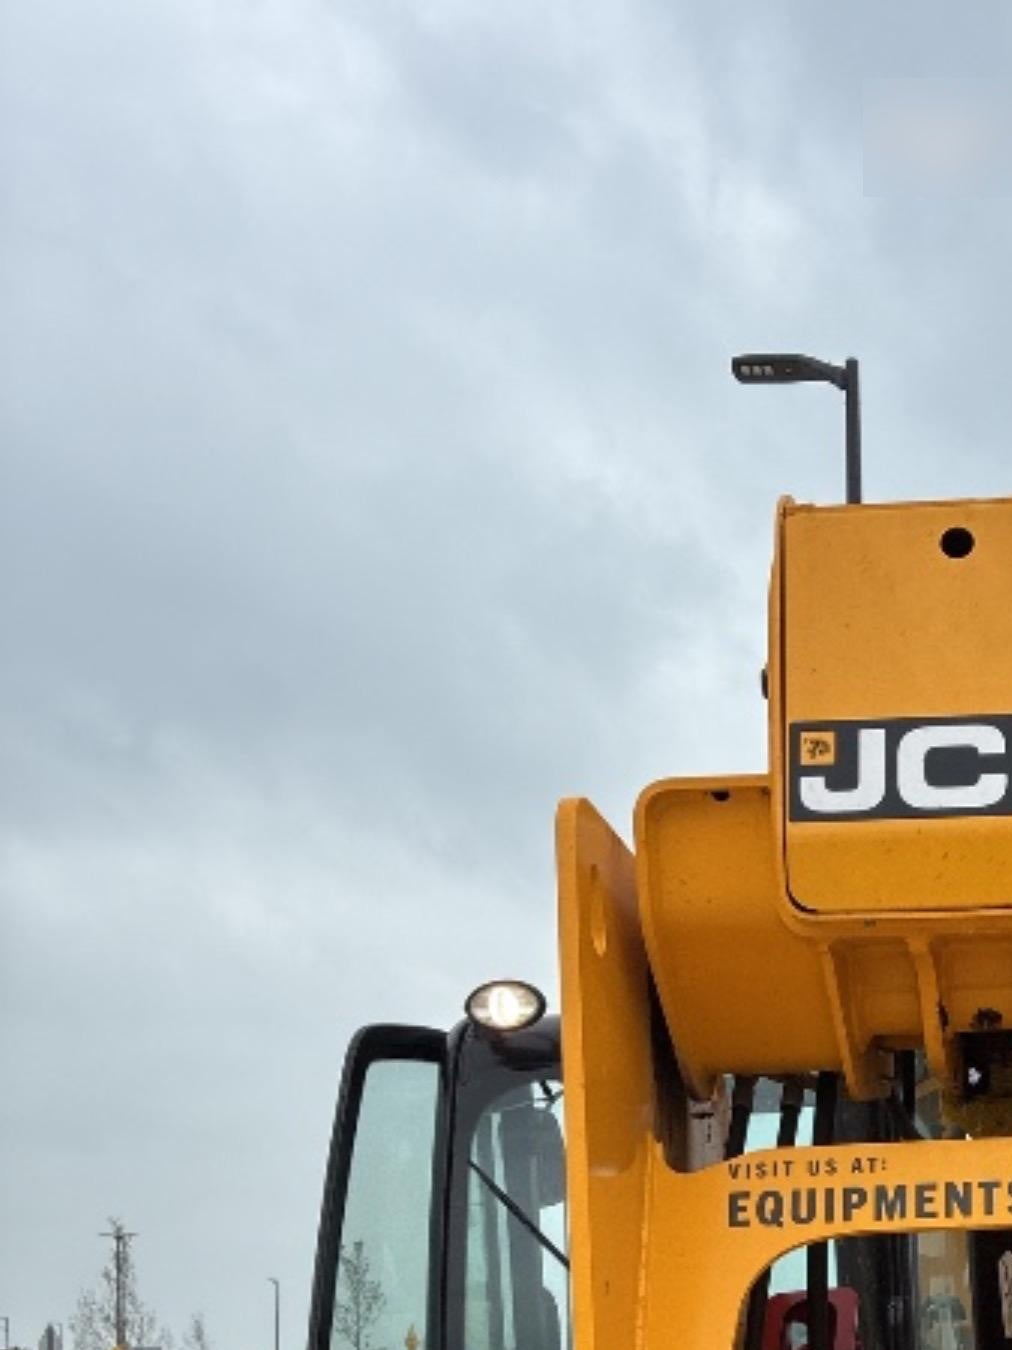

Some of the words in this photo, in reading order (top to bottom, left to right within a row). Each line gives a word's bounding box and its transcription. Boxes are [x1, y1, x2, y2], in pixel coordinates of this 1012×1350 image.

[728, 1160, 795, 1180] VISIT
[807, 1157, 838, 1177] US
[851, 1157, 888, 1174] AT:
